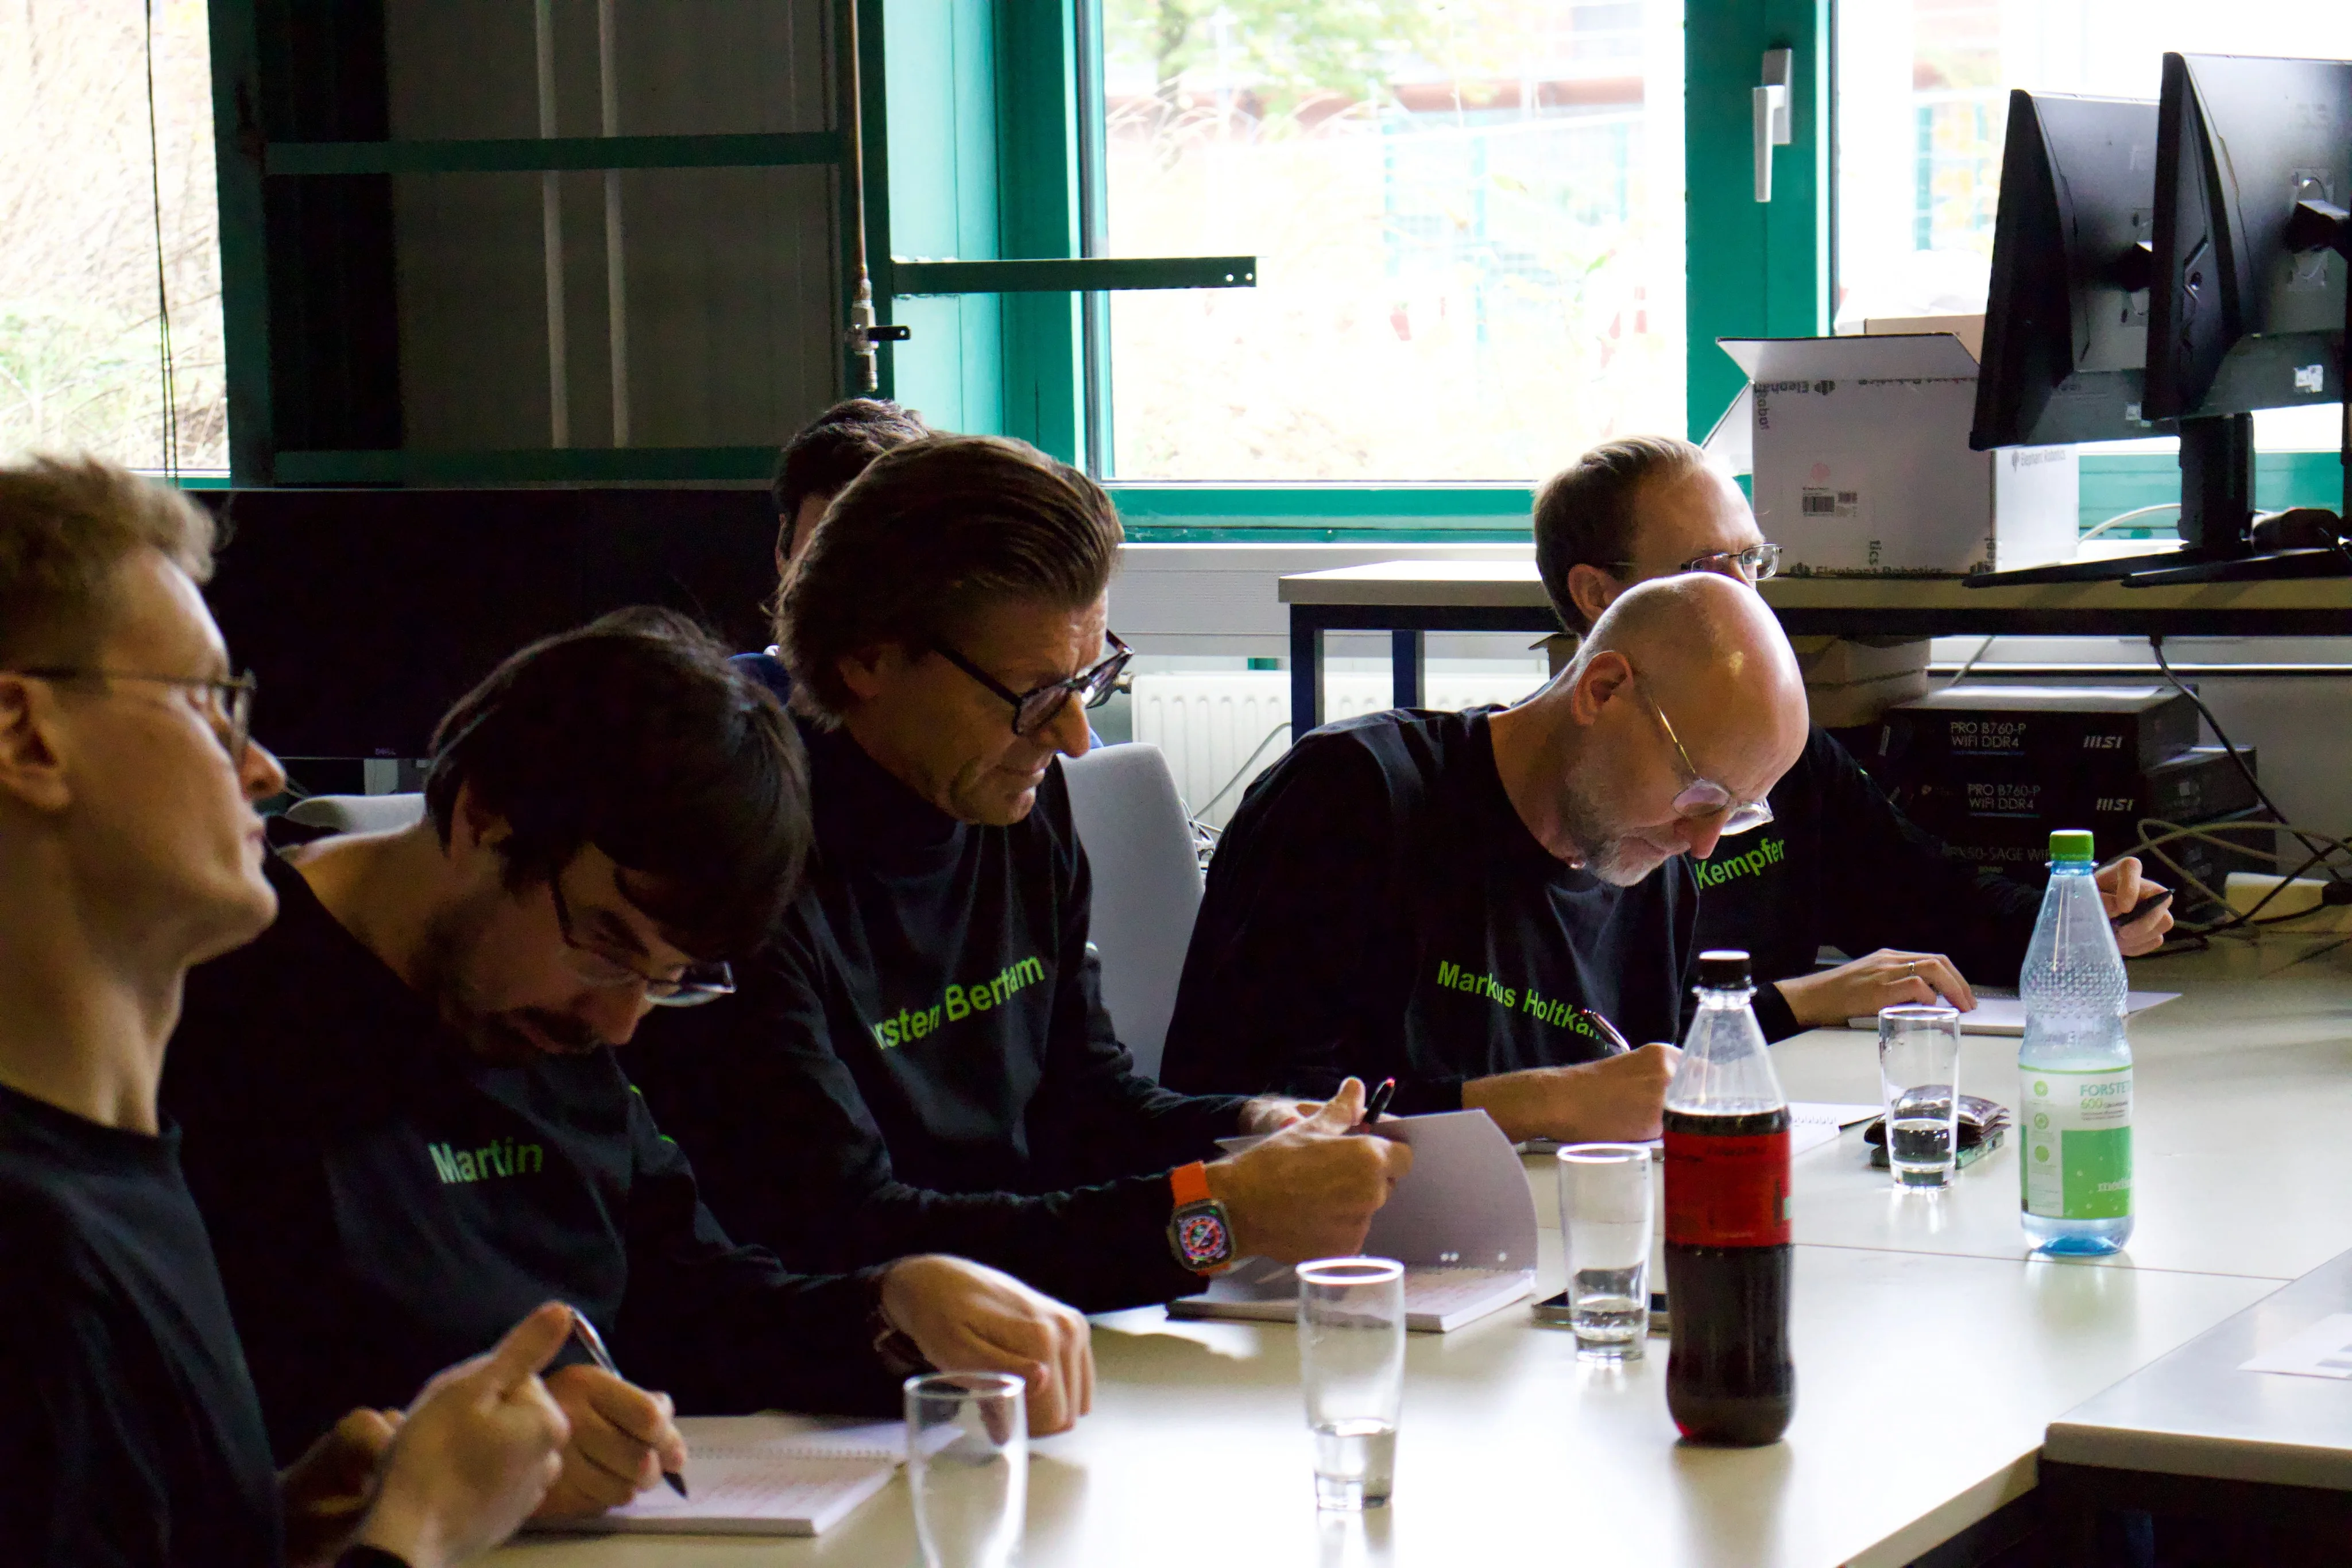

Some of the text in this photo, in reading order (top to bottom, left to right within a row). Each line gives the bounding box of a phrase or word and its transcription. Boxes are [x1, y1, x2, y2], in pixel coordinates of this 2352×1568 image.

[1950, 722, 2026, 735] PRO B760-P
[1981, 735, 2019, 748] DDR4
[1967, 783, 2041, 796] PRO B760-P
[1998, 797, 2034, 810] DDR4
[1695, 838, 1785, 891] Kempfer
[1437, 960, 1518, 1008] Markus
[427, 1136, 544, 1184] Martin
